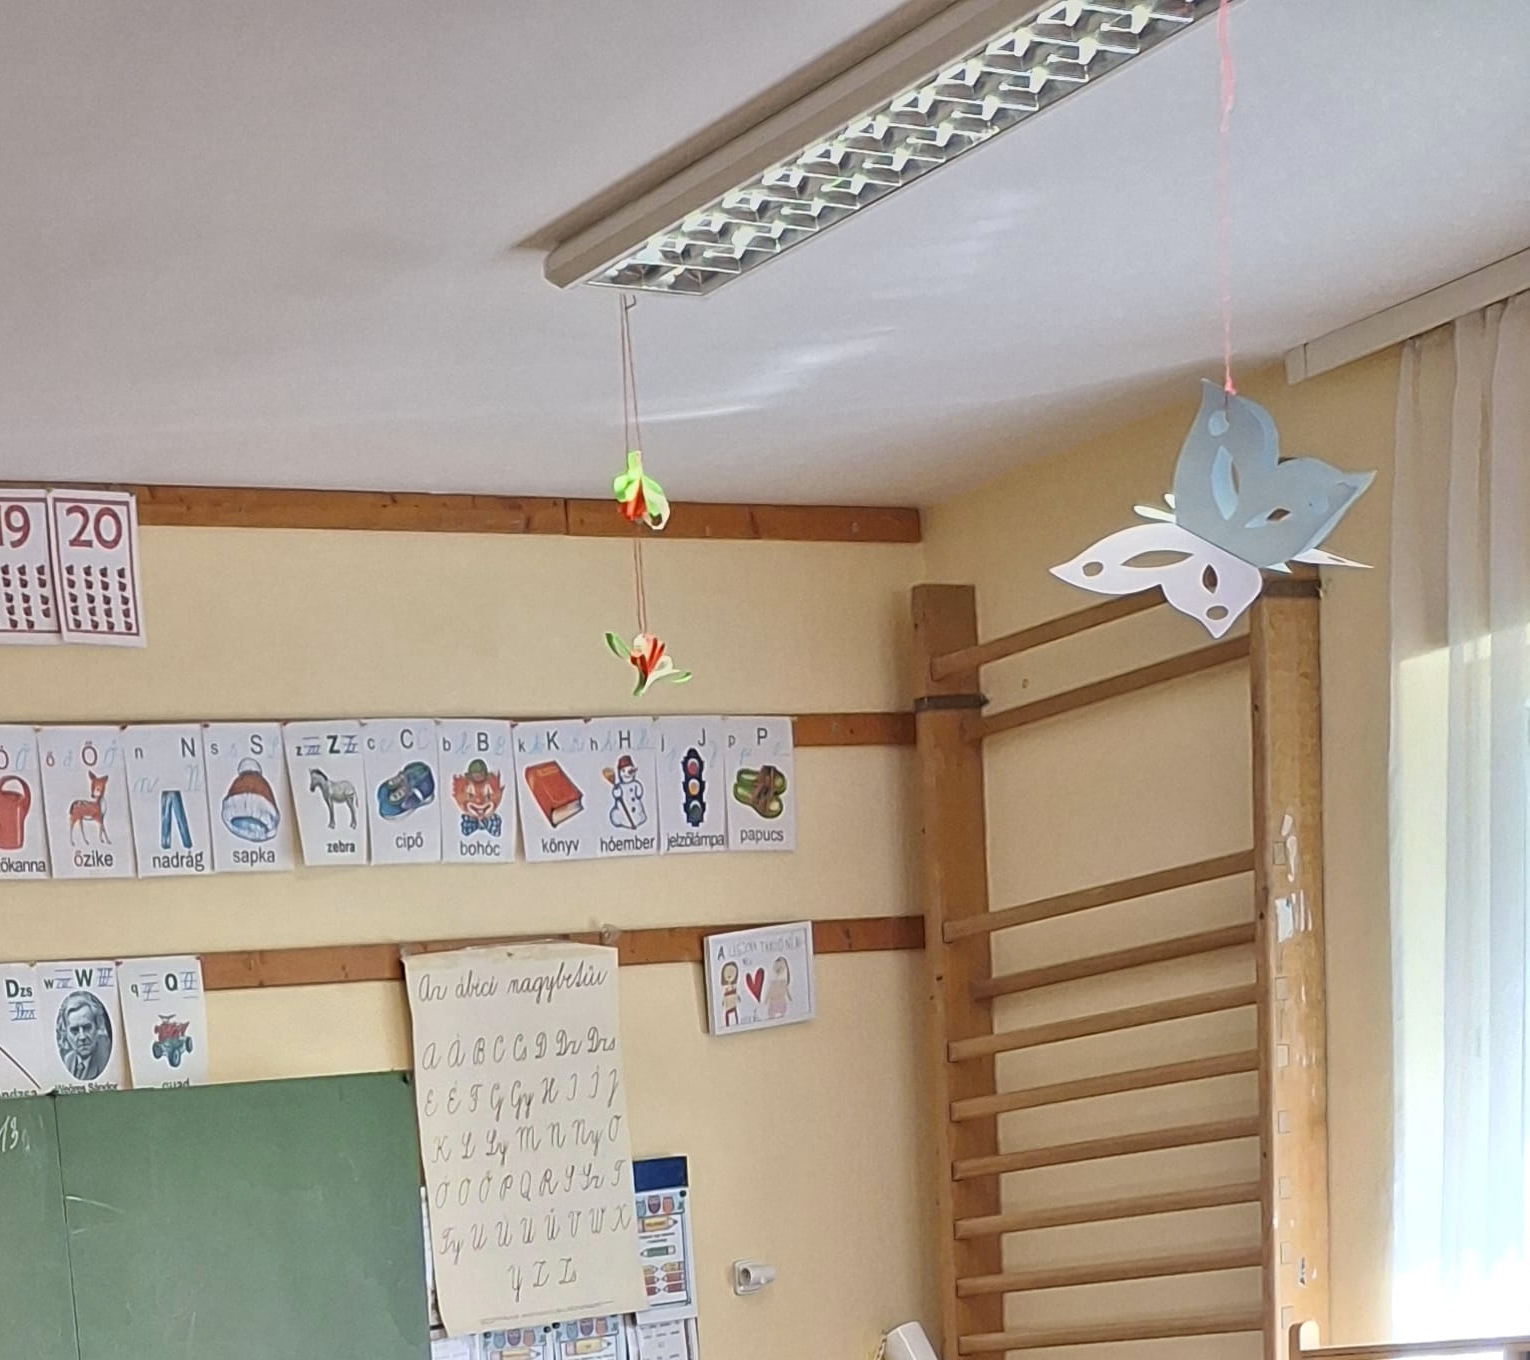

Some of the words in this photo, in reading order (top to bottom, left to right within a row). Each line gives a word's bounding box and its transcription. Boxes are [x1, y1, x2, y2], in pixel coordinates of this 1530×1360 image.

[66, 506, 124, 549] 20
[250, 734, 263, 755] S
[327, 735, 340, 753] Z
[400, 729, 414, 748] C
[477, 732, 489, 751] B
[546, 731, 558, 750] K
[619, 730, 631, 748] H
[756, 728, 768, 745] P
[180, 737, 195, 757] N
[600, 836, 655, 851] hóember
[740, 827, 784, 844] papucs
[233, 846, 275, 865] sapka
[327, 840, 355, 854] zebra
[460, 840, 501, 856] bohóc
[152, 848, 204, 871] nadrág
[74, 969, 93, 987] W
[165, 973, 178, 991] Q
[5, 978, 33, 998] Dzs
